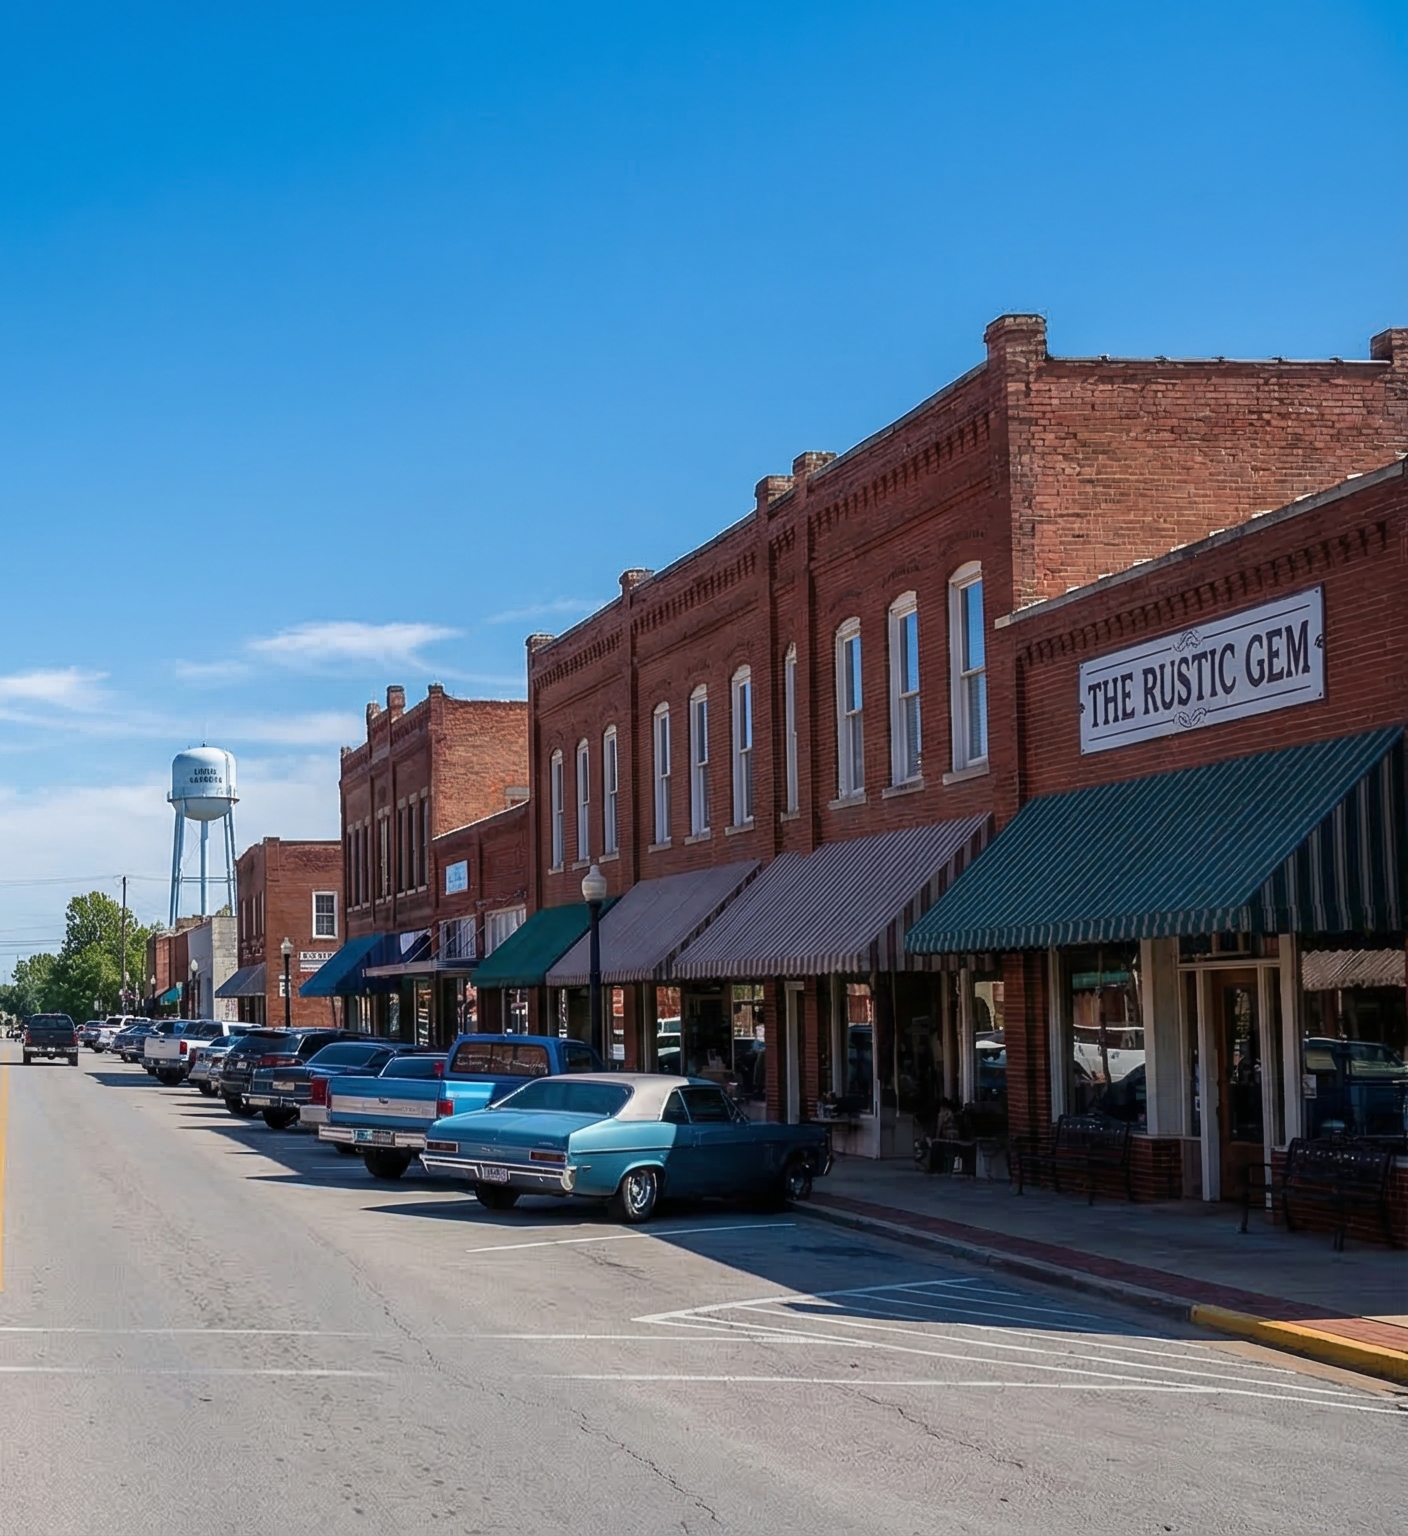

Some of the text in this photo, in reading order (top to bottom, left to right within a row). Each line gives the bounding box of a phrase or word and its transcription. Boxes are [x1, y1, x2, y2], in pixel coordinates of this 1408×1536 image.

[1087, 619, 1311, 729] THE RUSTIC GEM
